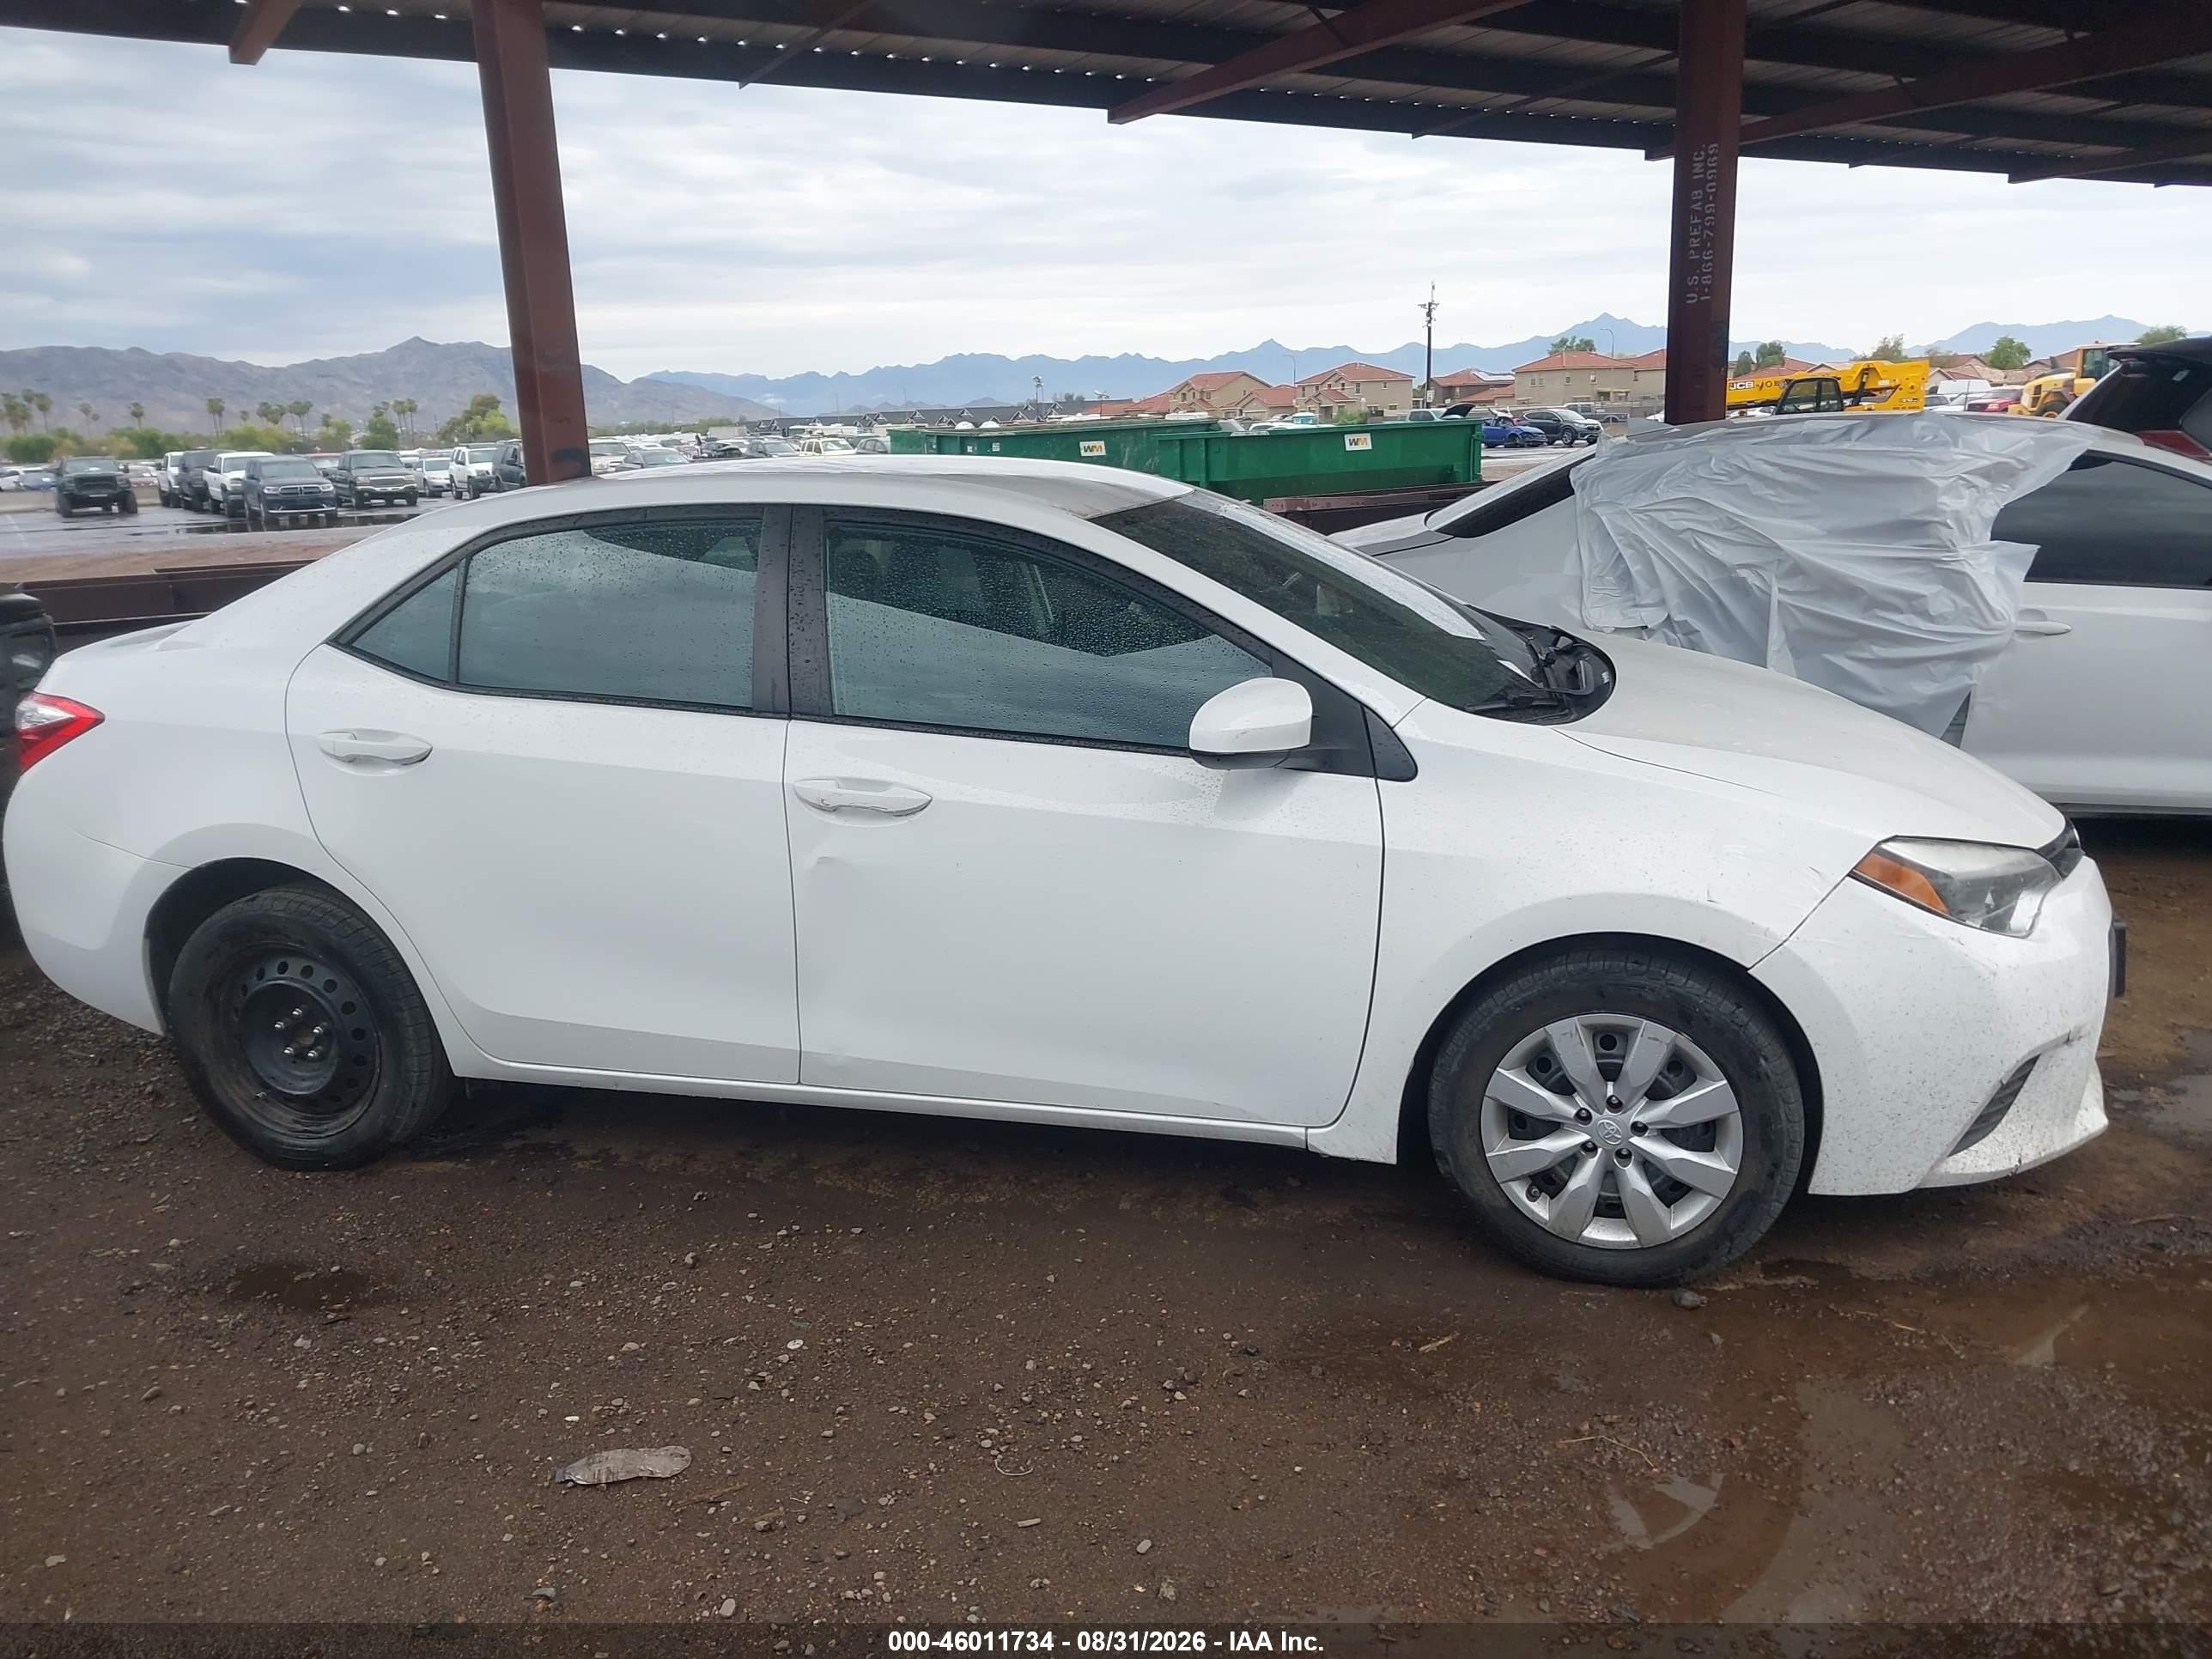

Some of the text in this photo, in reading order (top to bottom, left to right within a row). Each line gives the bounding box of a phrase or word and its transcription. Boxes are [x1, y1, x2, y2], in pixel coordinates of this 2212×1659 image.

[1686, 143, 1706, 304] U.S. PREFAB INC.
[1700, 143, 1719, 301] 1-866-799-0969
[1729, 381, 1754, 390] JCB
[1348, 437, 1368, 447] WM
[1083, 445, 1103, 453] WM
